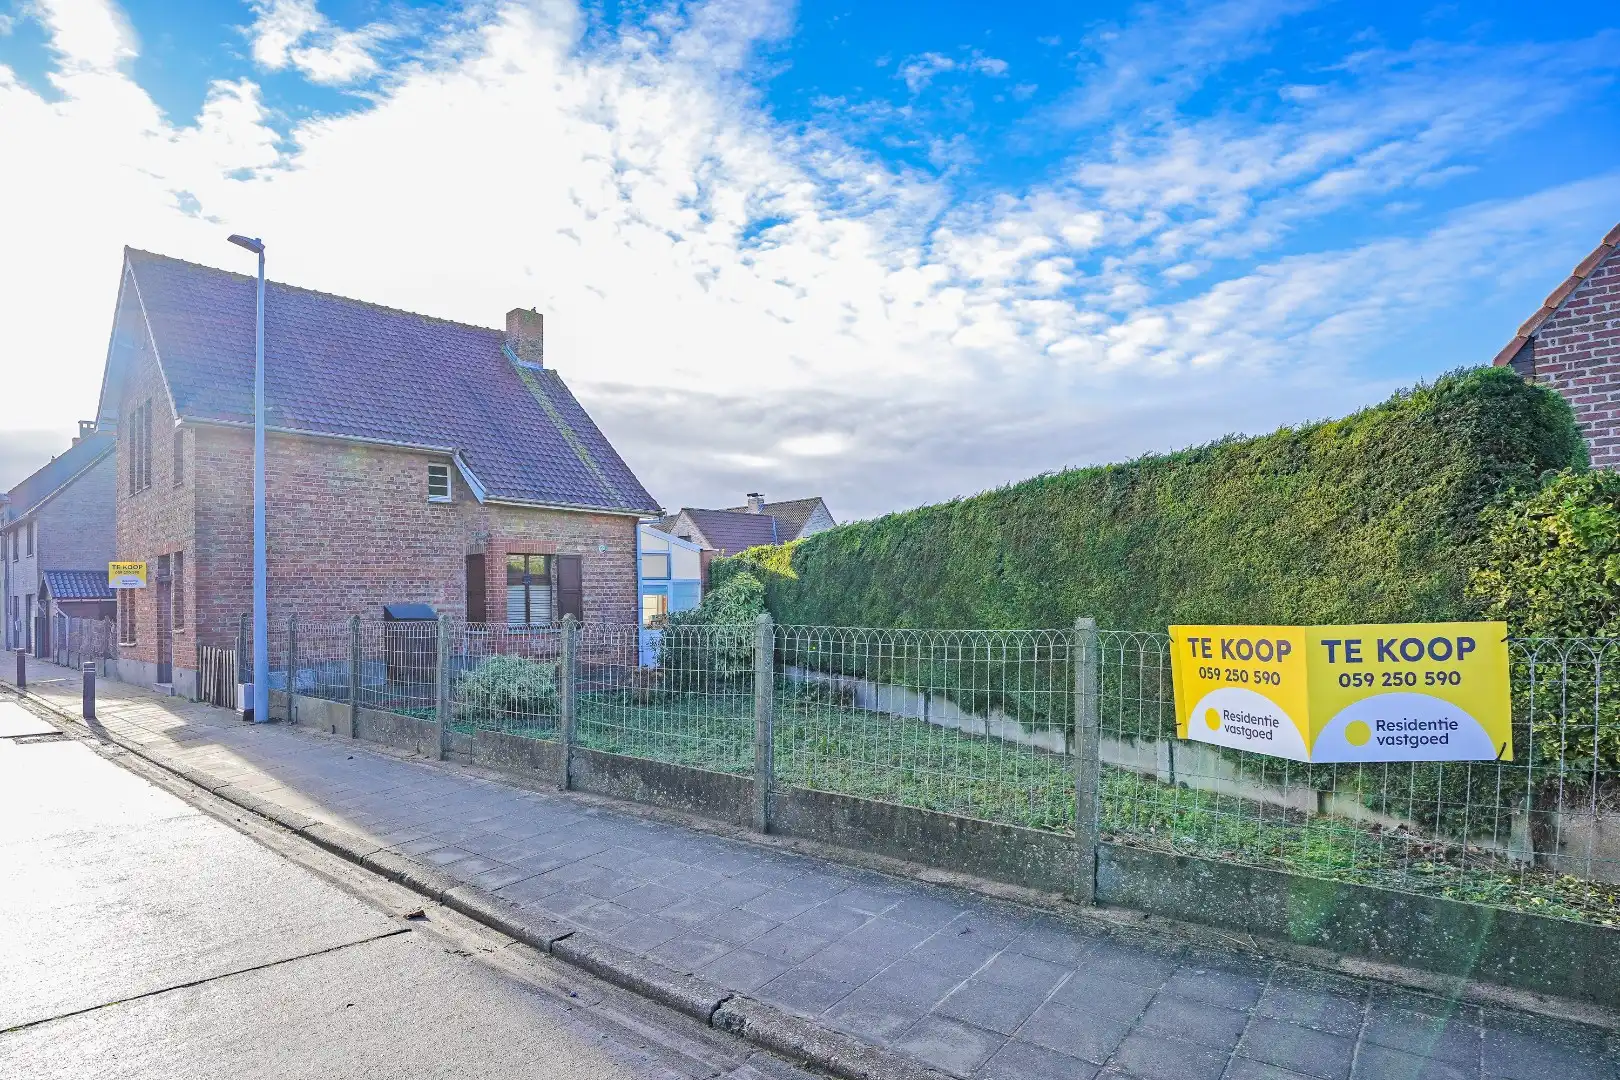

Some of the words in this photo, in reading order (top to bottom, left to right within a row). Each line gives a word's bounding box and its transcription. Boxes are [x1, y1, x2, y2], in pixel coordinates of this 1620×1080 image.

[1187, 637, 1213, 659] TE
[1220, 638, 1292, 663] KOOP
[1320, 639, 1363, 664] TE
[1376, 636, 1476, 663] KOOP
[1199, 666, 1221, 681] 059
[1224, 668, 1249, 683] 250
[1253, 670, 1281, 686] 590
[1338, 672, 1375, 688] 059
[1381, 671, 1417, 687] 250
[1424, 670, 1462, 686] 590
[1223, 709, 1280, 728] Residentie
[1376, 717, 1459, 732] Residentie
[1224, 724, 1273, 741] vastgoed
[1376, 732, 1449, 749] vastgoed
